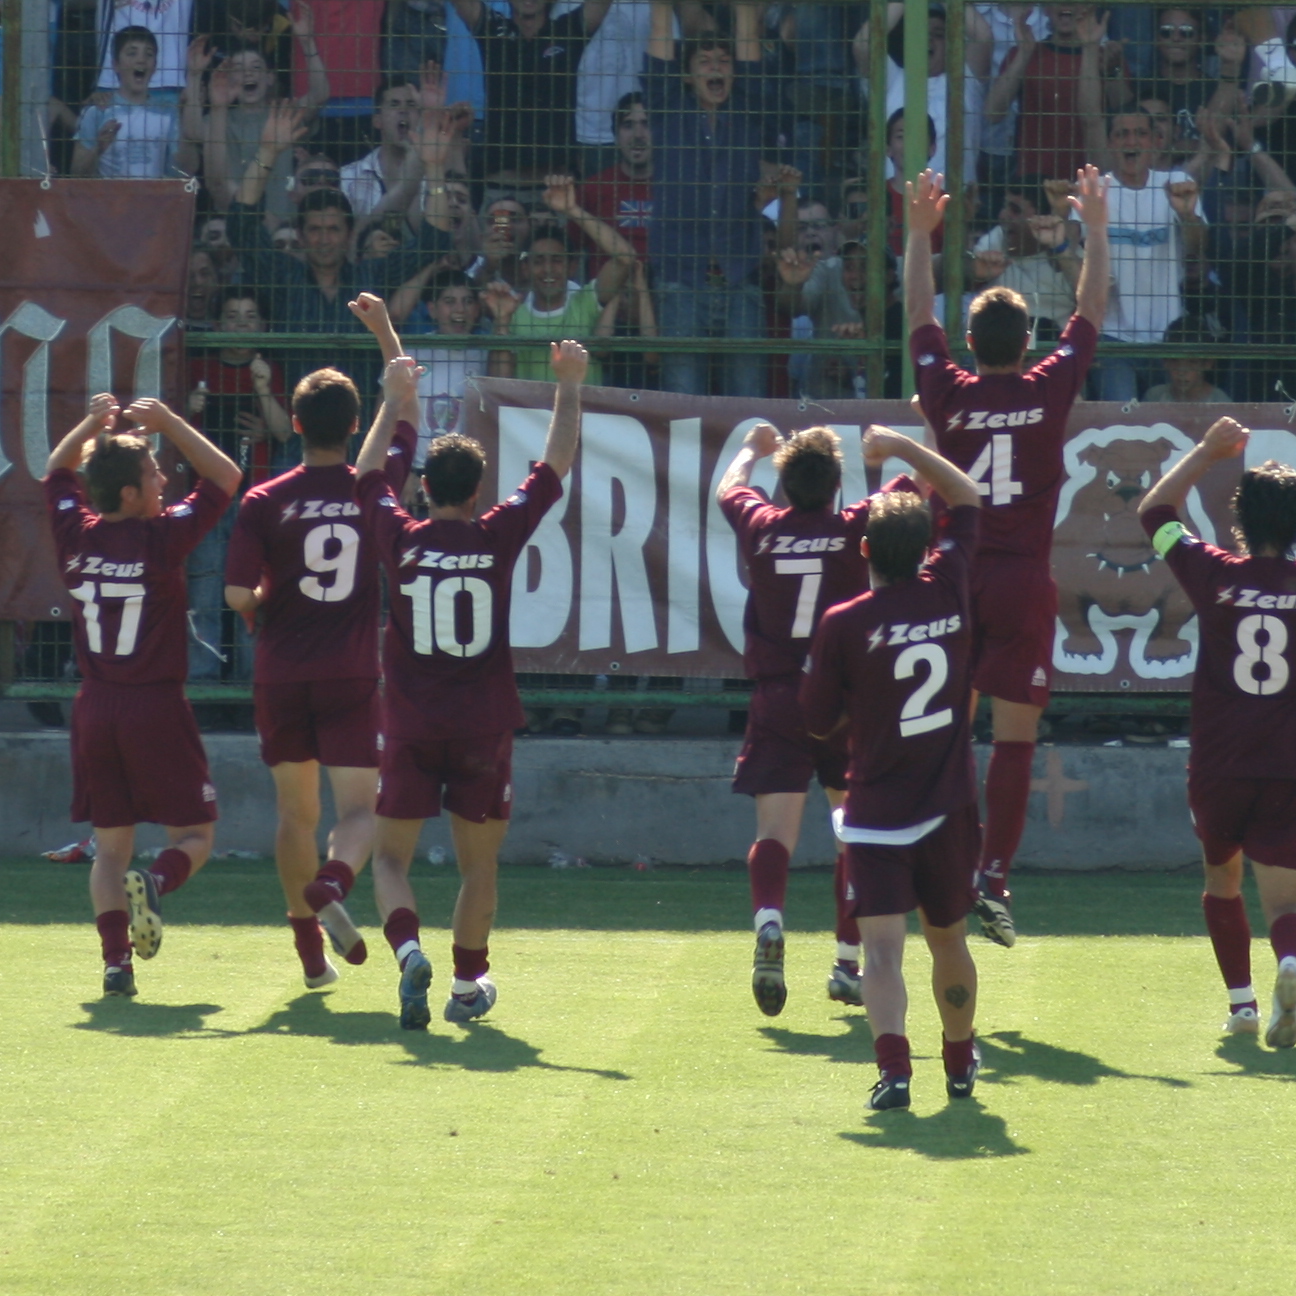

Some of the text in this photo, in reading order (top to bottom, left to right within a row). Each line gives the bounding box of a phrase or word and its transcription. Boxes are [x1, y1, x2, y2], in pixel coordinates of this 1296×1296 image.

[963, 407, 1044, 430] Zeus
[970, 433, 1023, 506] 4
[298, 499, 359, 519] Zeu
[770, 535, 846, 554] Zeus
[80, 555, 145, 578] Zeus
[301, 522, 360, 603] 9
[417, 549, 494, 571] Zeus
[68, 581, 147, 657] 17
[400, 575, 493, 658] 10
[774, 557, 824, 639] 7
[886, 614, 962, 645] Zeus
[892, 642, 954, 738] 2
[1232, 613, 1290, 696] 8
